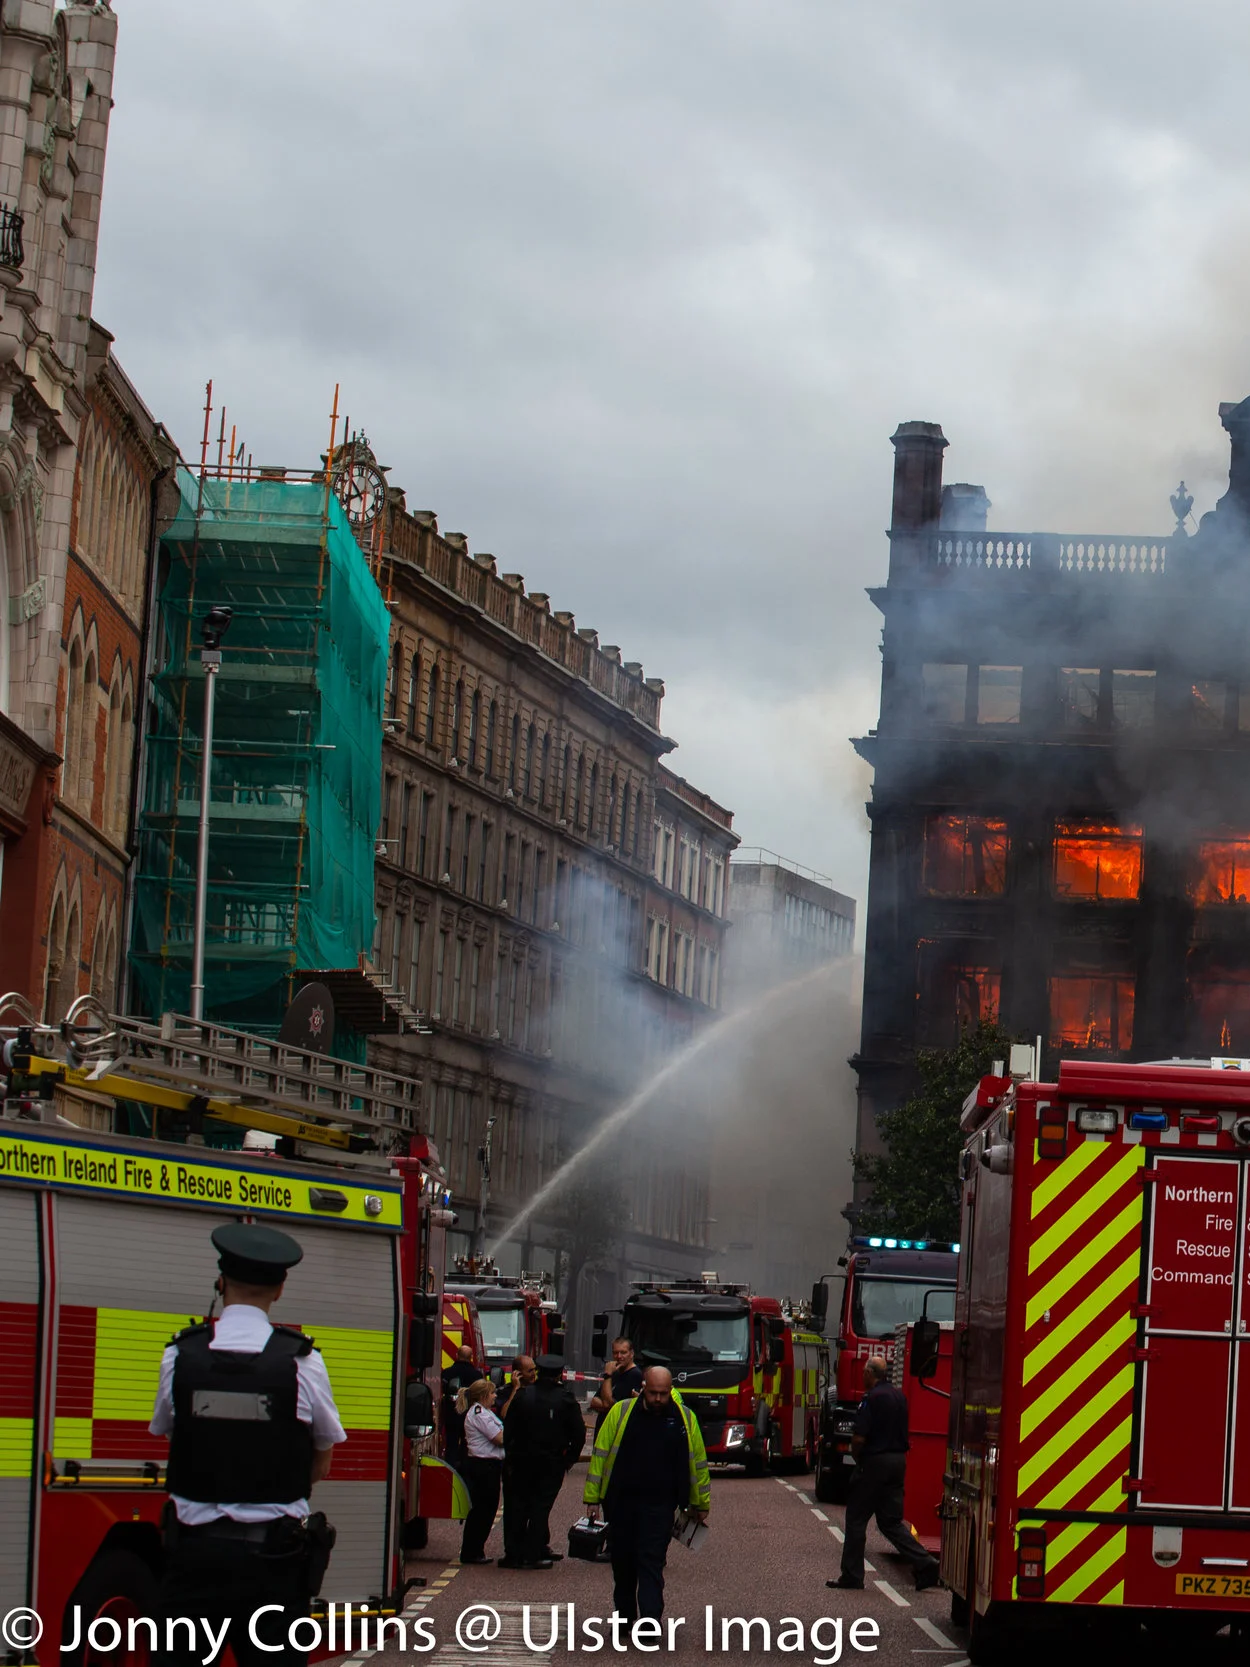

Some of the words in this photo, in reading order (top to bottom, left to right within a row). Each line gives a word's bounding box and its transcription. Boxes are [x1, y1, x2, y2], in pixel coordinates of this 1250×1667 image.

[63, 1150, 117, 1184] Ireland
[124, 1159, 152, 1189] Fire
[160, 1164, 171, 1191] &
[177, 1167, 232, 1199] Rescue
[239, 1175, 291, 1208] Service
[1165, 1185, 1233, 1203] Northern
[1206, 1214, 1233, 1231] Fire
[1176, 1239, 1231, 1258] Rescue
[1151, 1267, 1234, 1285] Command
[1182, 1576, 1217, 1595] PKZ
